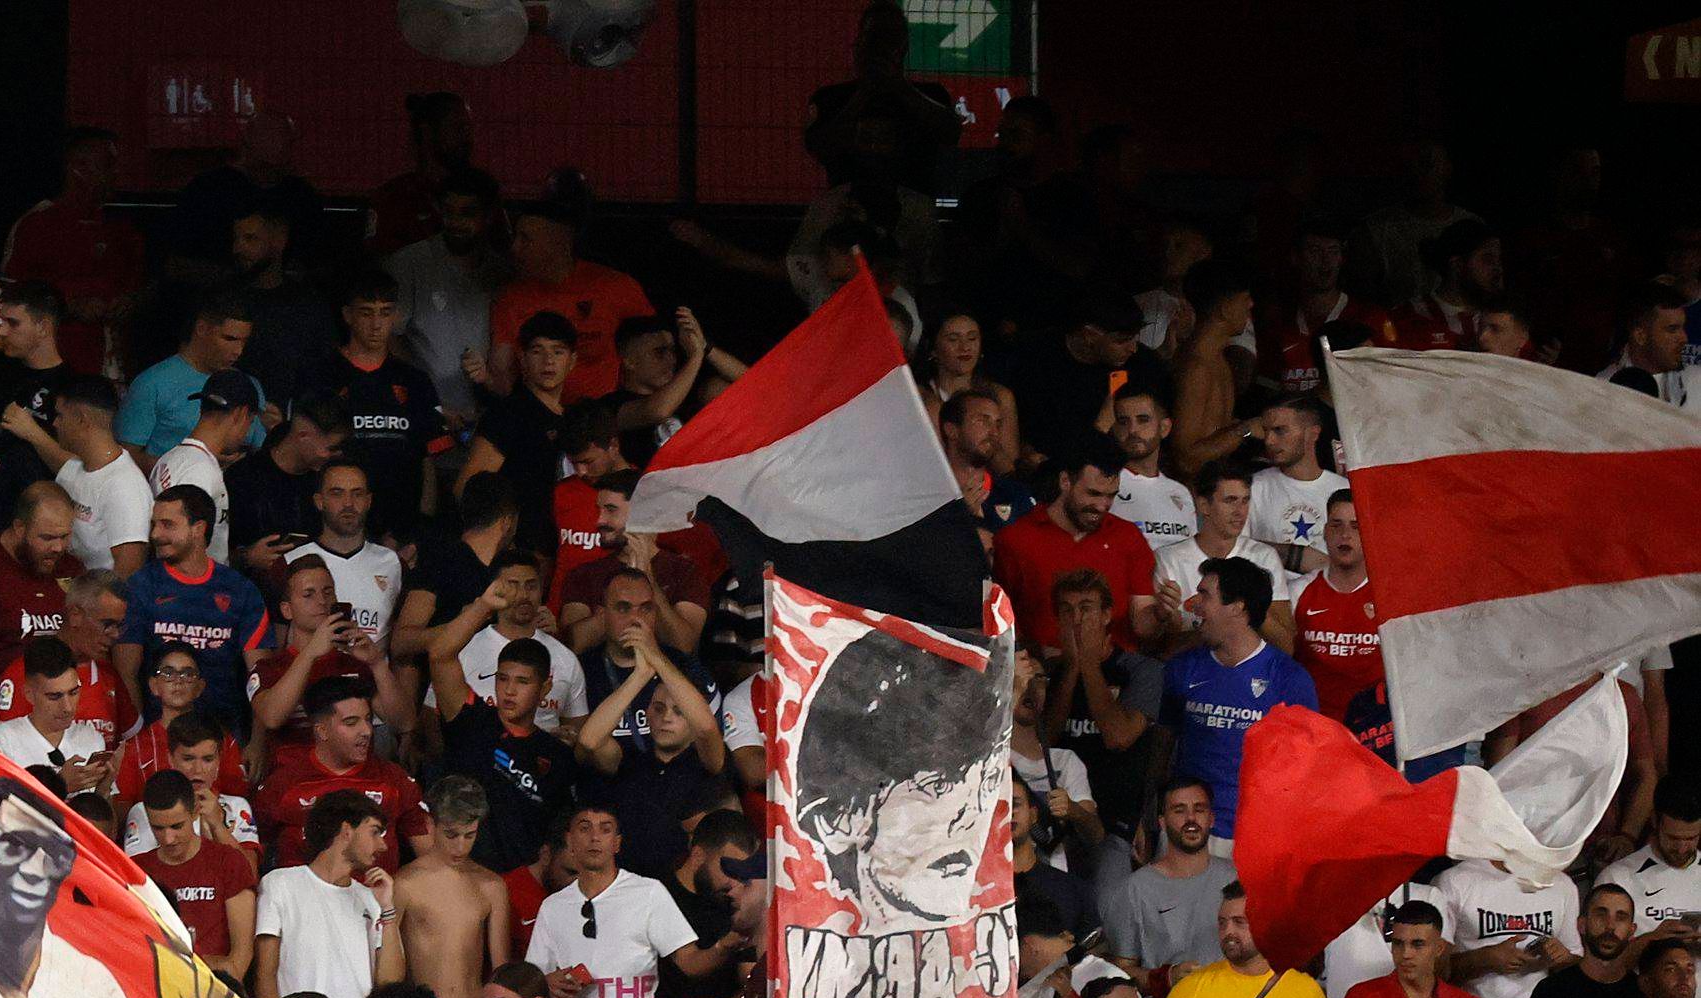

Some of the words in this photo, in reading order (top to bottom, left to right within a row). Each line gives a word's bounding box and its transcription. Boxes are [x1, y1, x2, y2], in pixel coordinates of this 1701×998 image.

[352, 415, 409, 431] DEGIRO
[153, 621, 232, 639] MARATHON
[1328, 643, 1357, 657] BET
[1185, 701, 1262, 721] MARATHON
[1205, 714, 1233, 730] BET
